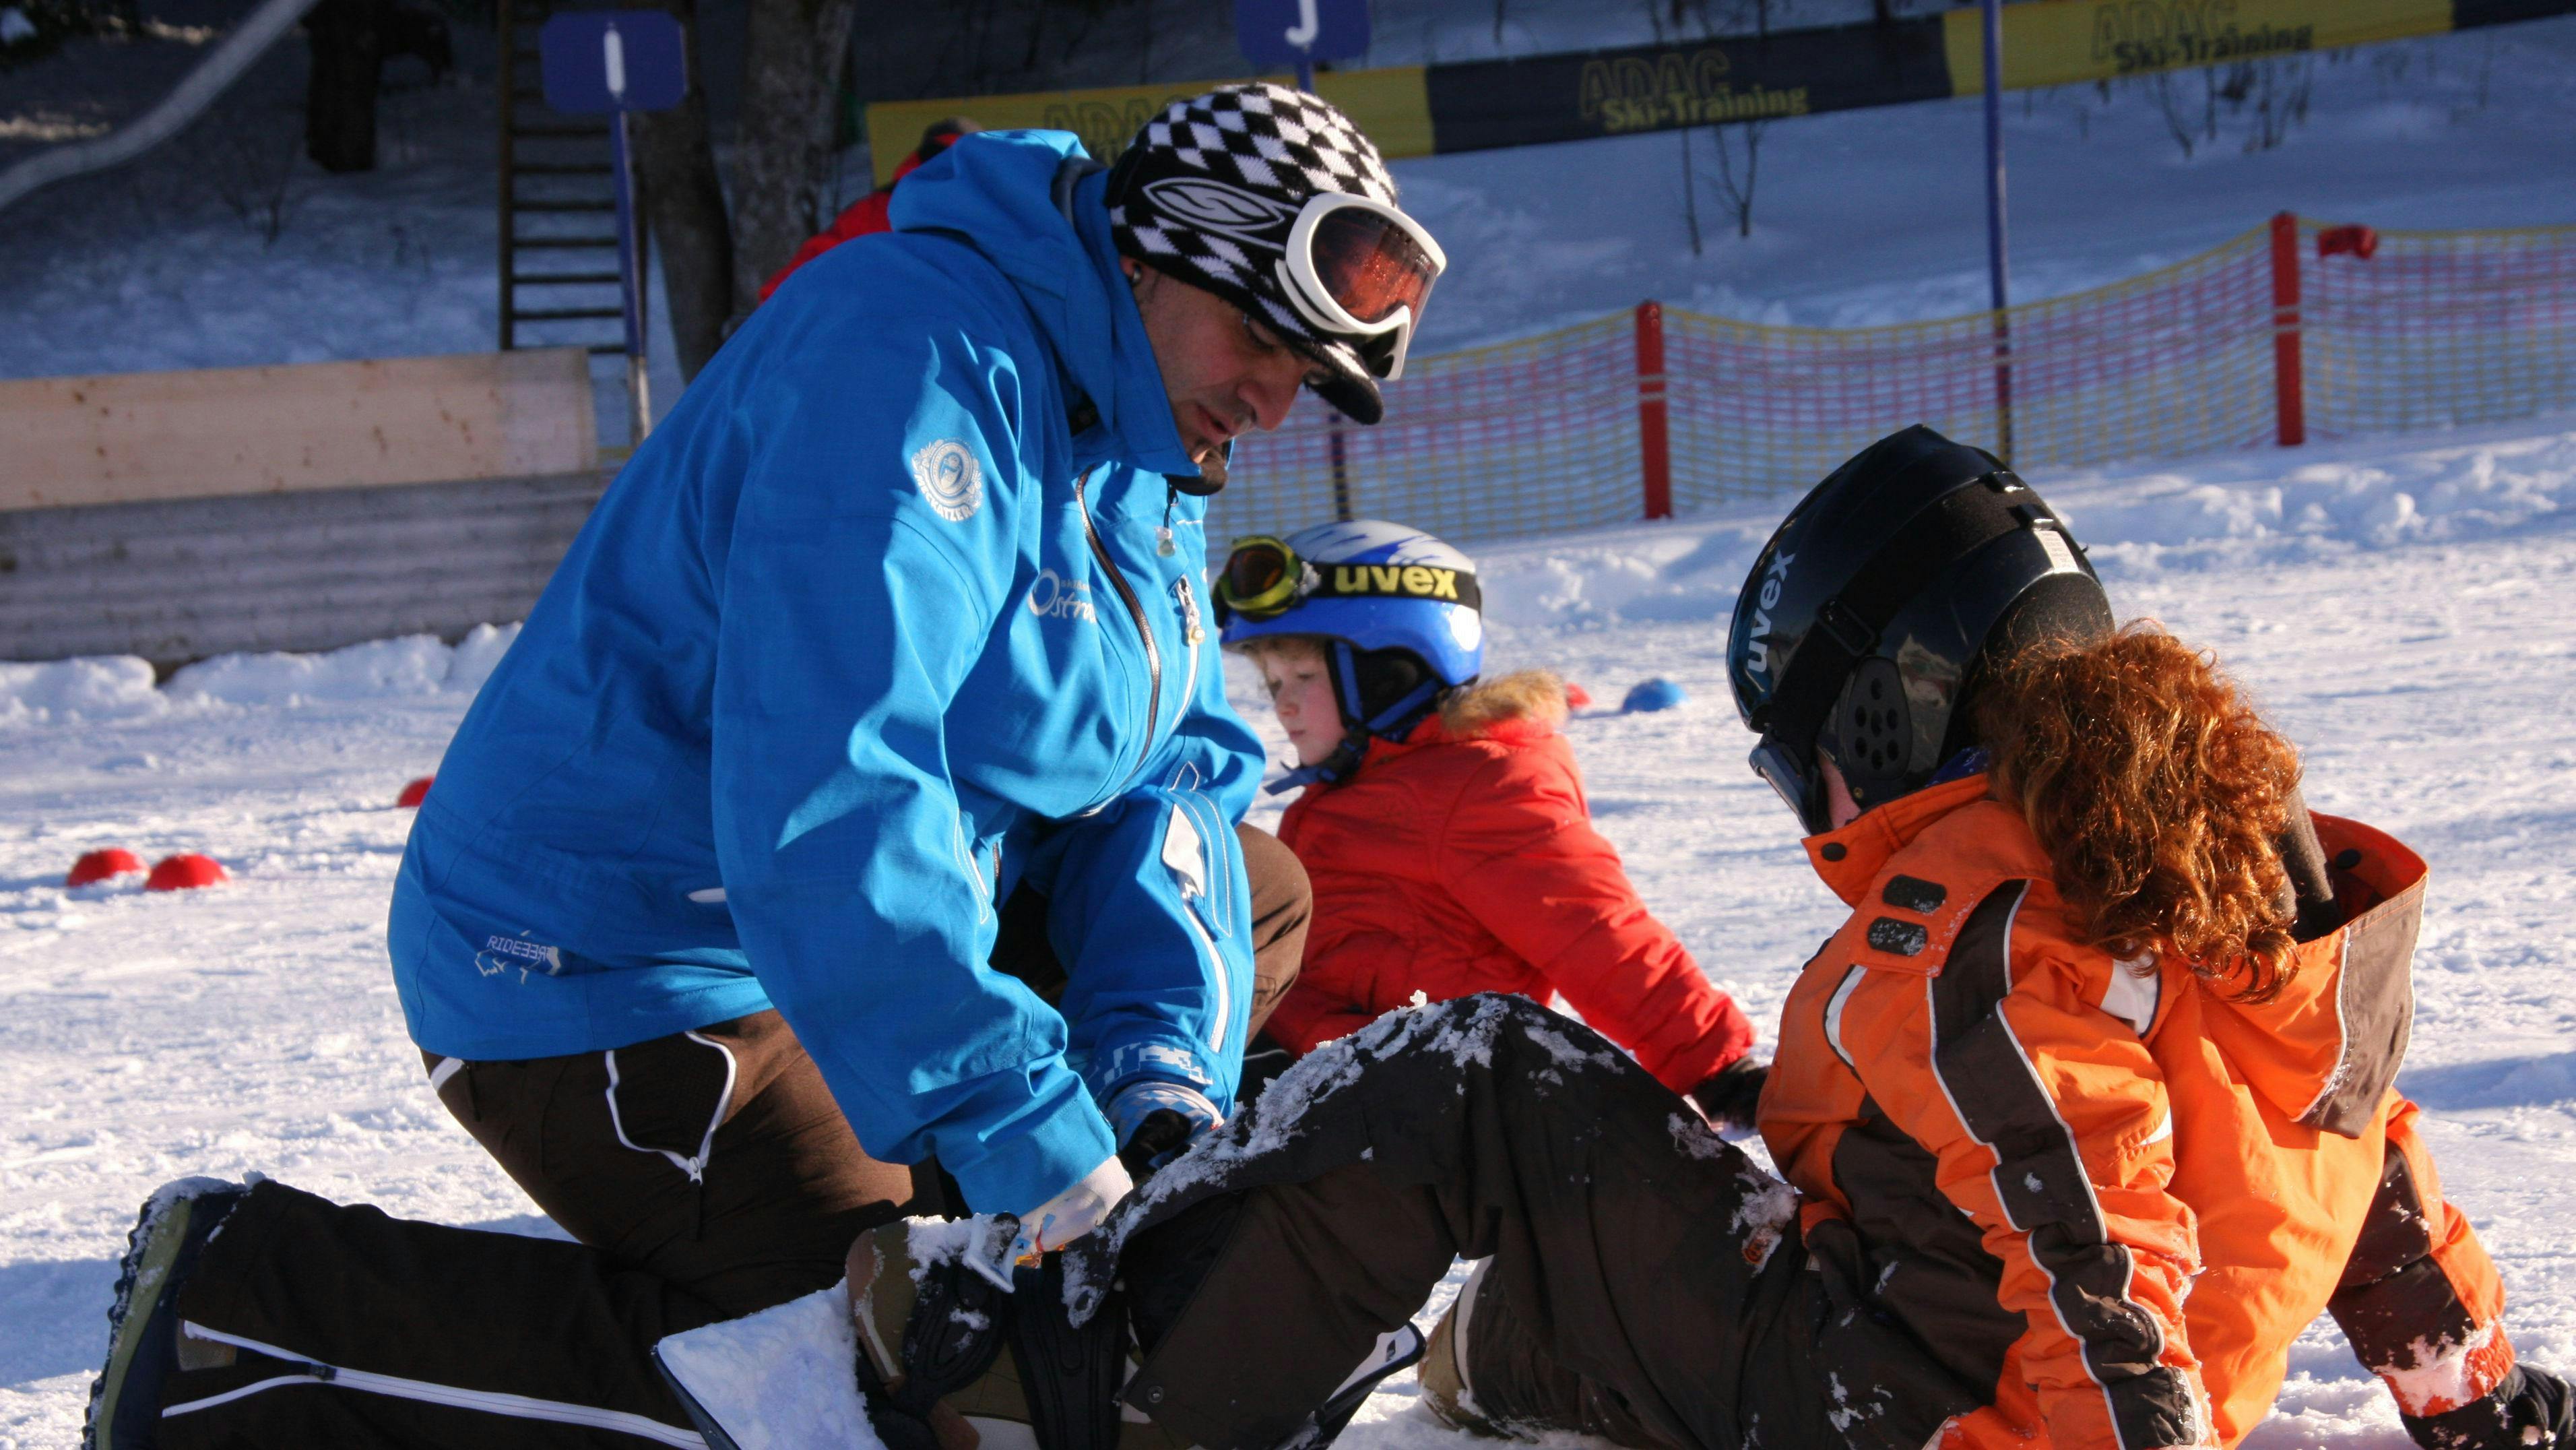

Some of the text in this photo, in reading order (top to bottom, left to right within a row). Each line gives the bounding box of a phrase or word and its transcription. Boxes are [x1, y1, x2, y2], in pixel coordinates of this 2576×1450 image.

[2113, 24, 2313, 73] Ski-Training
[1578, 49, 1731, 121] ADAC
[1601, 82, 1809, 133] Ski-Training
[1334, 565, 1459, 600] uvex
[1747, 548, 1796, 674] uvex
